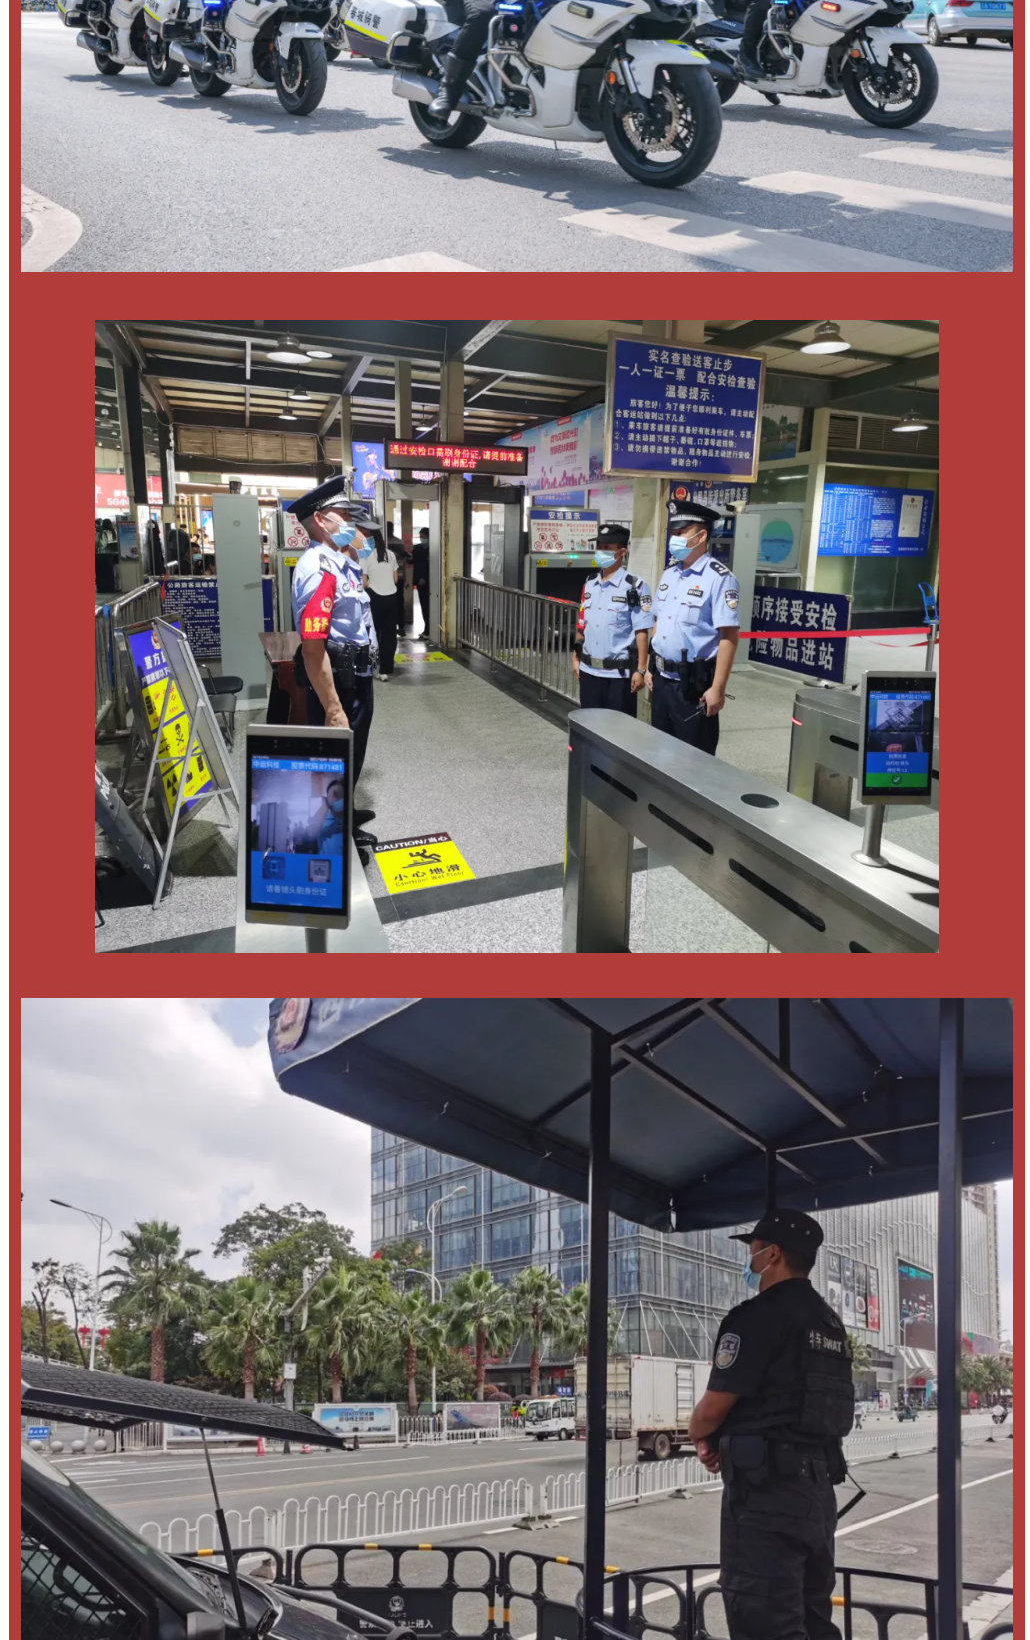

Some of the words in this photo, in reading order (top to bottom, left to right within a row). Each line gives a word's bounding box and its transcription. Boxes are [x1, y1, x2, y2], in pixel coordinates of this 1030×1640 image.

[648, 348, 733, 372] 实名查验送客止步
[618, 362, 686, 382] 一人一证一票
[696, 371, 756, 390] 配合安检查验
[751, 630, 834, 671] 险物品进站
[394, 864, 460, 882] 小心地滑
[823, 1337, 843, 1353] SWAT
